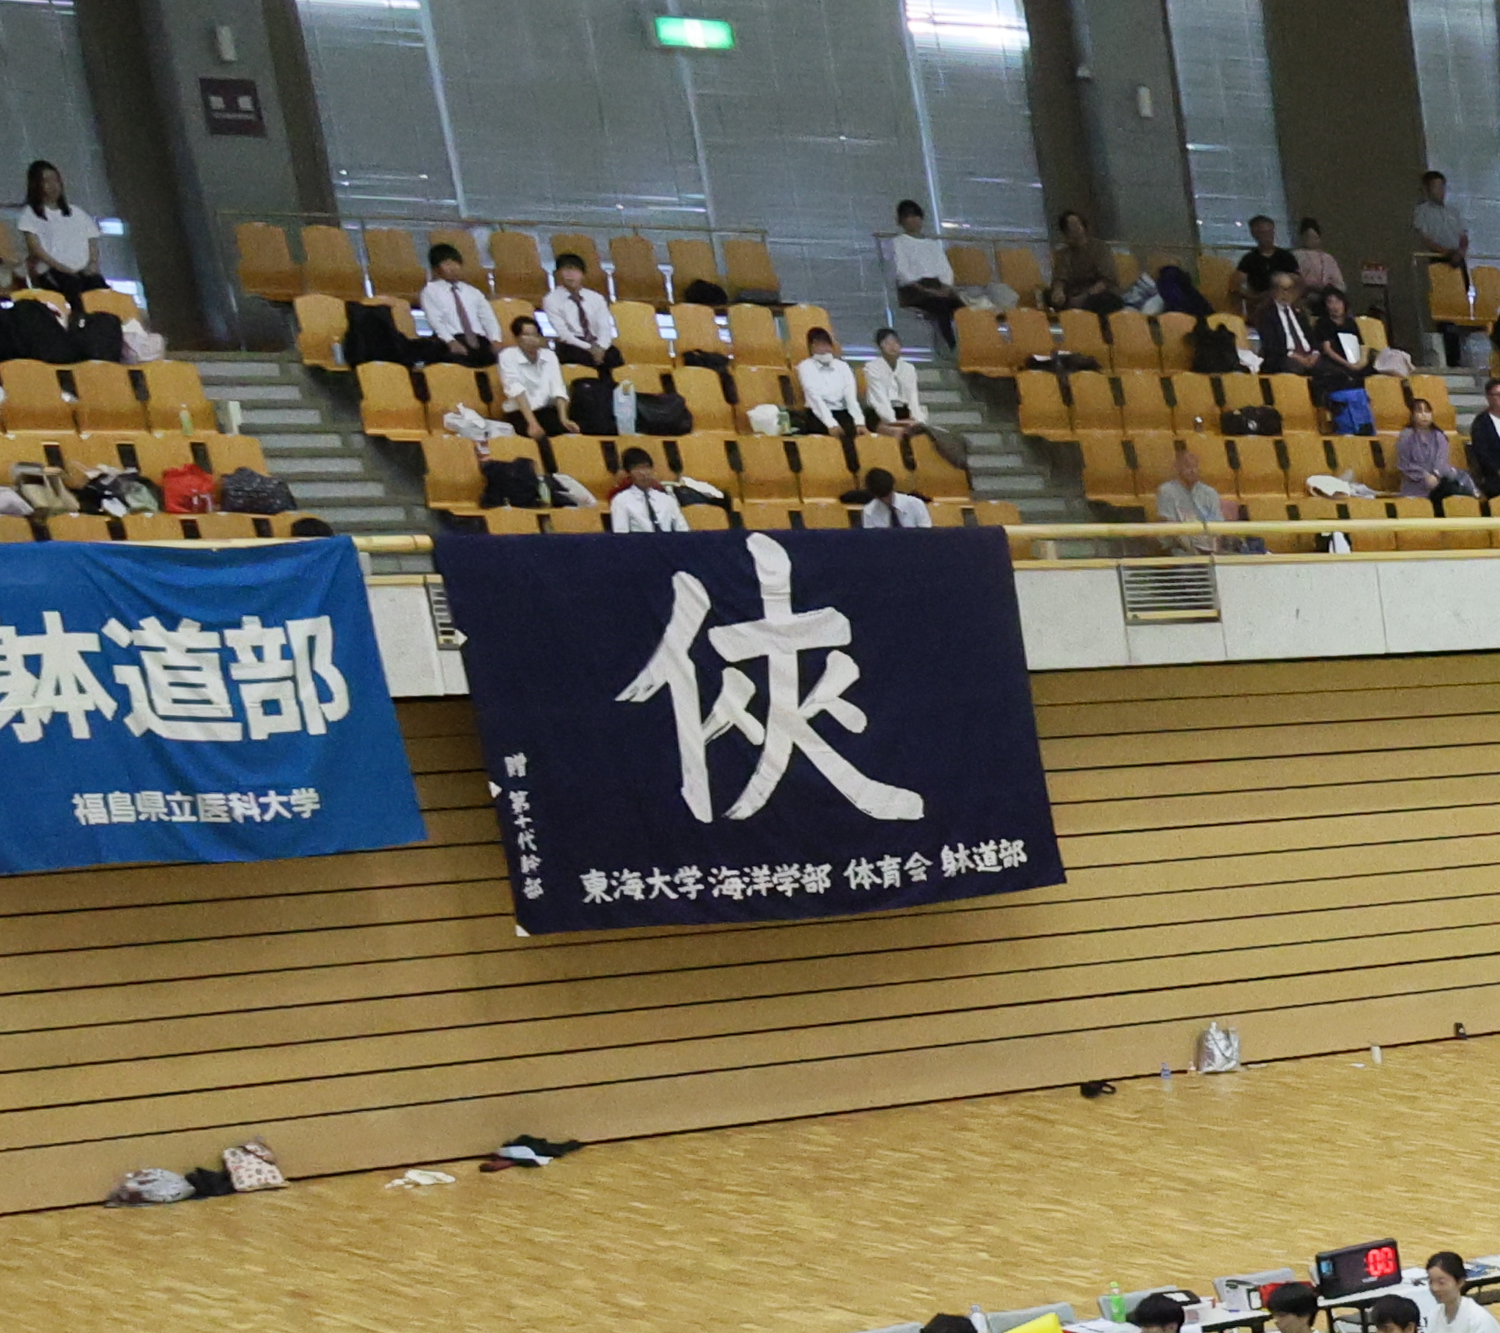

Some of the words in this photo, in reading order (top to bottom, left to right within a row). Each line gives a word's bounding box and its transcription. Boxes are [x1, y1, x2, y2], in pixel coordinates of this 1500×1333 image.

[72, 787, 321, 826] 福島県立医科大学
[844, 853, 934, 890] 体育会
[940, 838, 1029, 873] 躰道部
